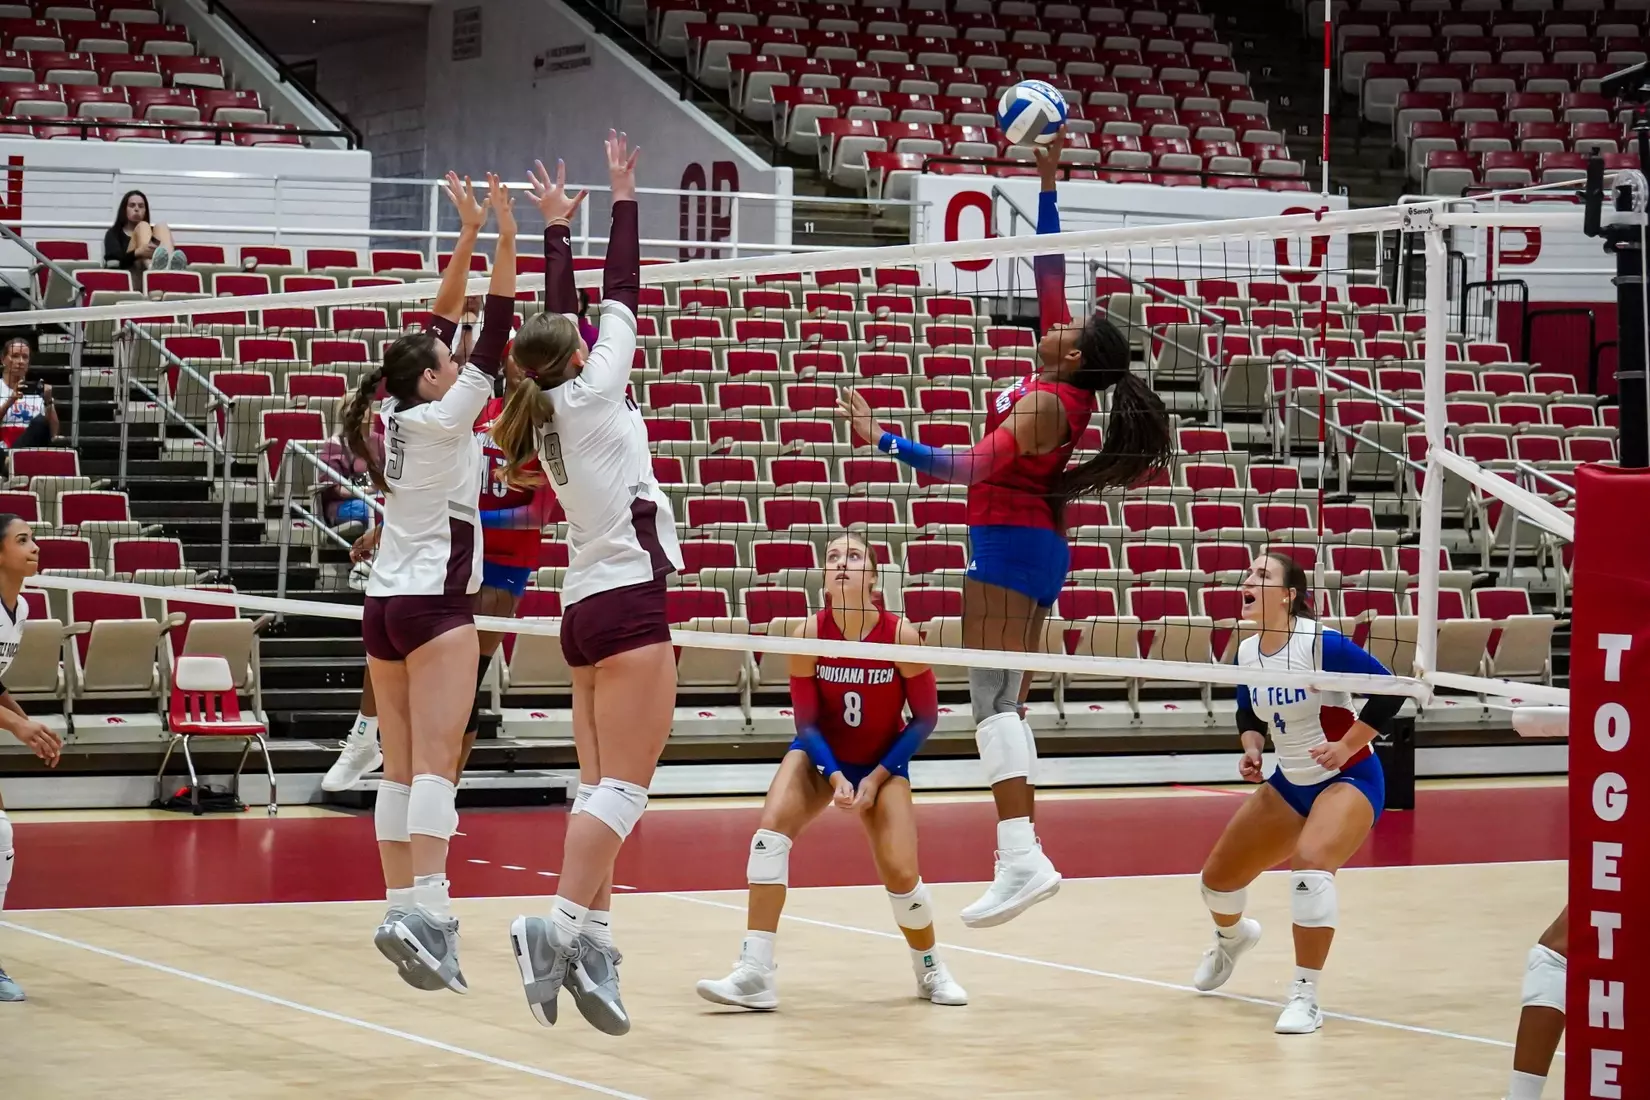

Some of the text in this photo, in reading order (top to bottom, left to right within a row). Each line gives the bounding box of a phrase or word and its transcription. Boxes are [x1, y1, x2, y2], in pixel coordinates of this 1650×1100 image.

[1262, 67, 1272, 76] 17
[1280, 96, 1290, 106] 16
[1298, 125, 1308, 135] 15
[1338, 186, 1348, 196] 13
[1413, 207, 1433, 215] Senoh
[804, 222, 815, 233] 11
[386, 437, 405, 480] 5
[868, 668, 894, 685] TECH
[843, 691, 861, 727] 8
[1273, 712, 1287, 734] 4
